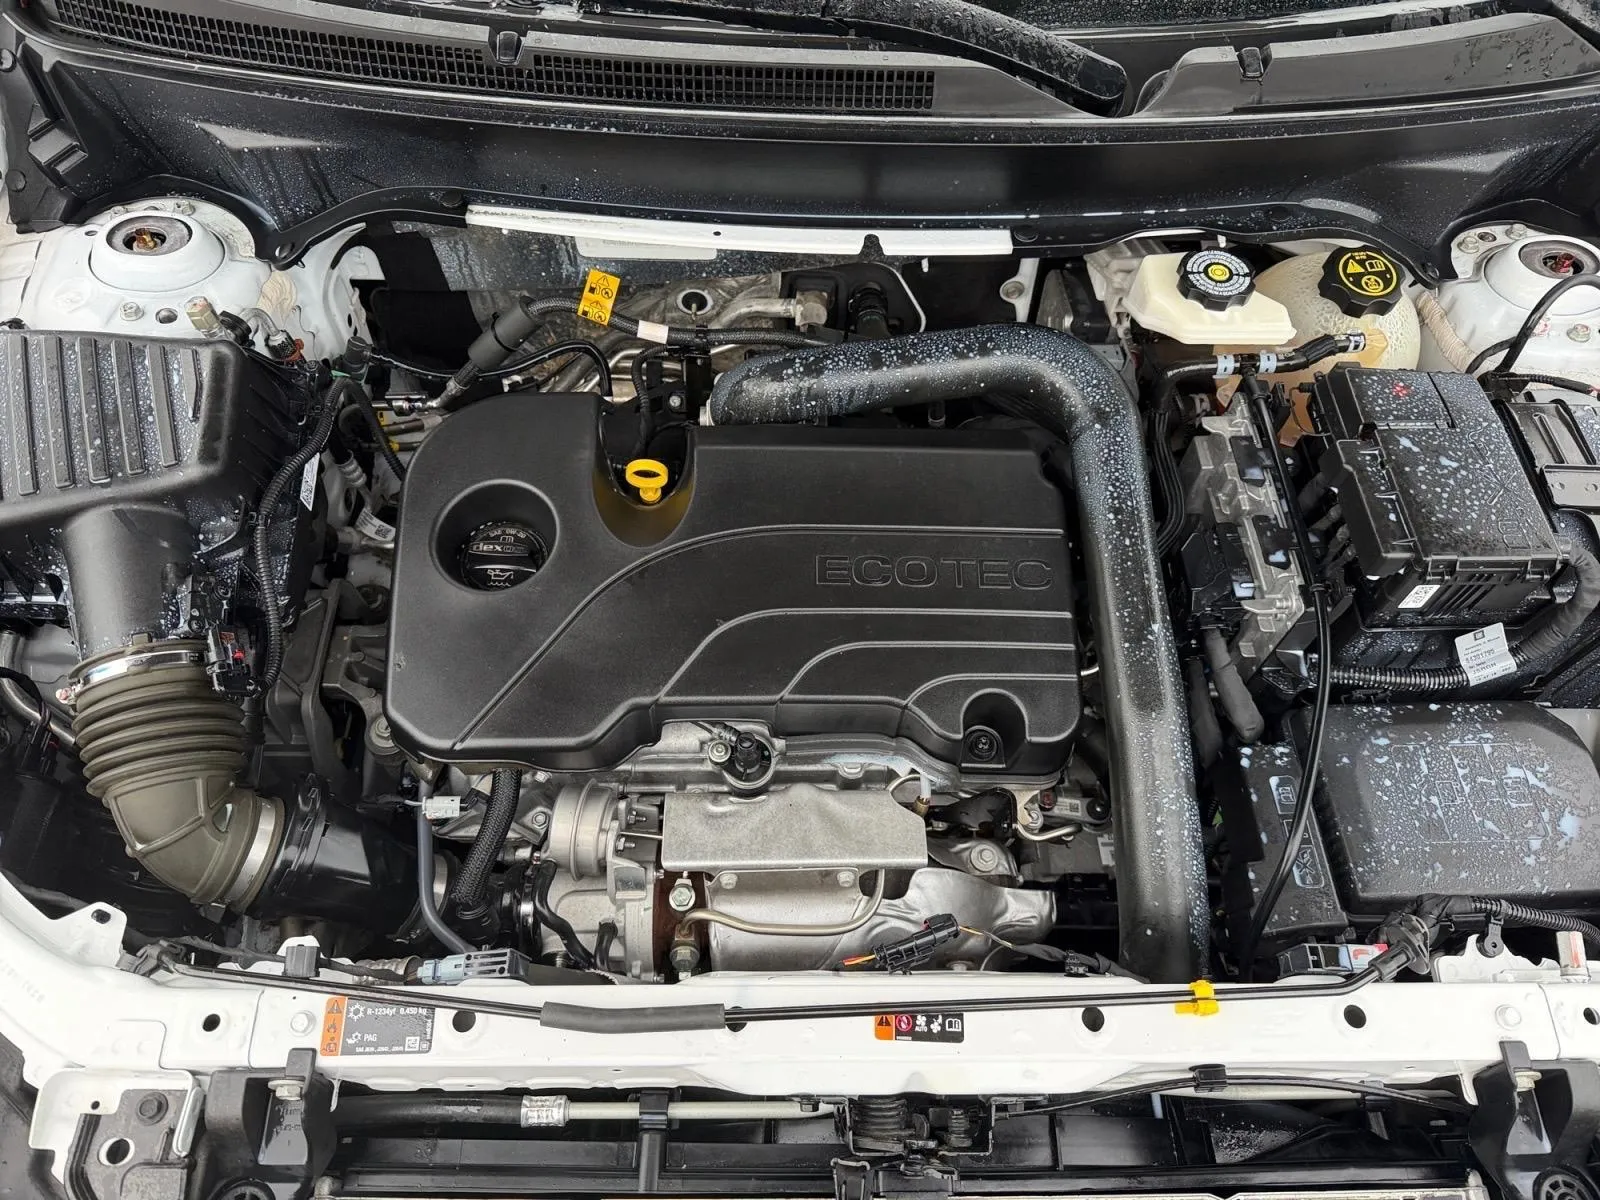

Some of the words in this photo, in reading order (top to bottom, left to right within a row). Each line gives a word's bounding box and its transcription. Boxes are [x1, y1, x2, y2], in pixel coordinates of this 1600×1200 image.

[815, 555, 1052, 590] ECOTEC
[366, 1007, 396, 1016] R-1234yf
[363, 1033, 377, 1042] PAG
